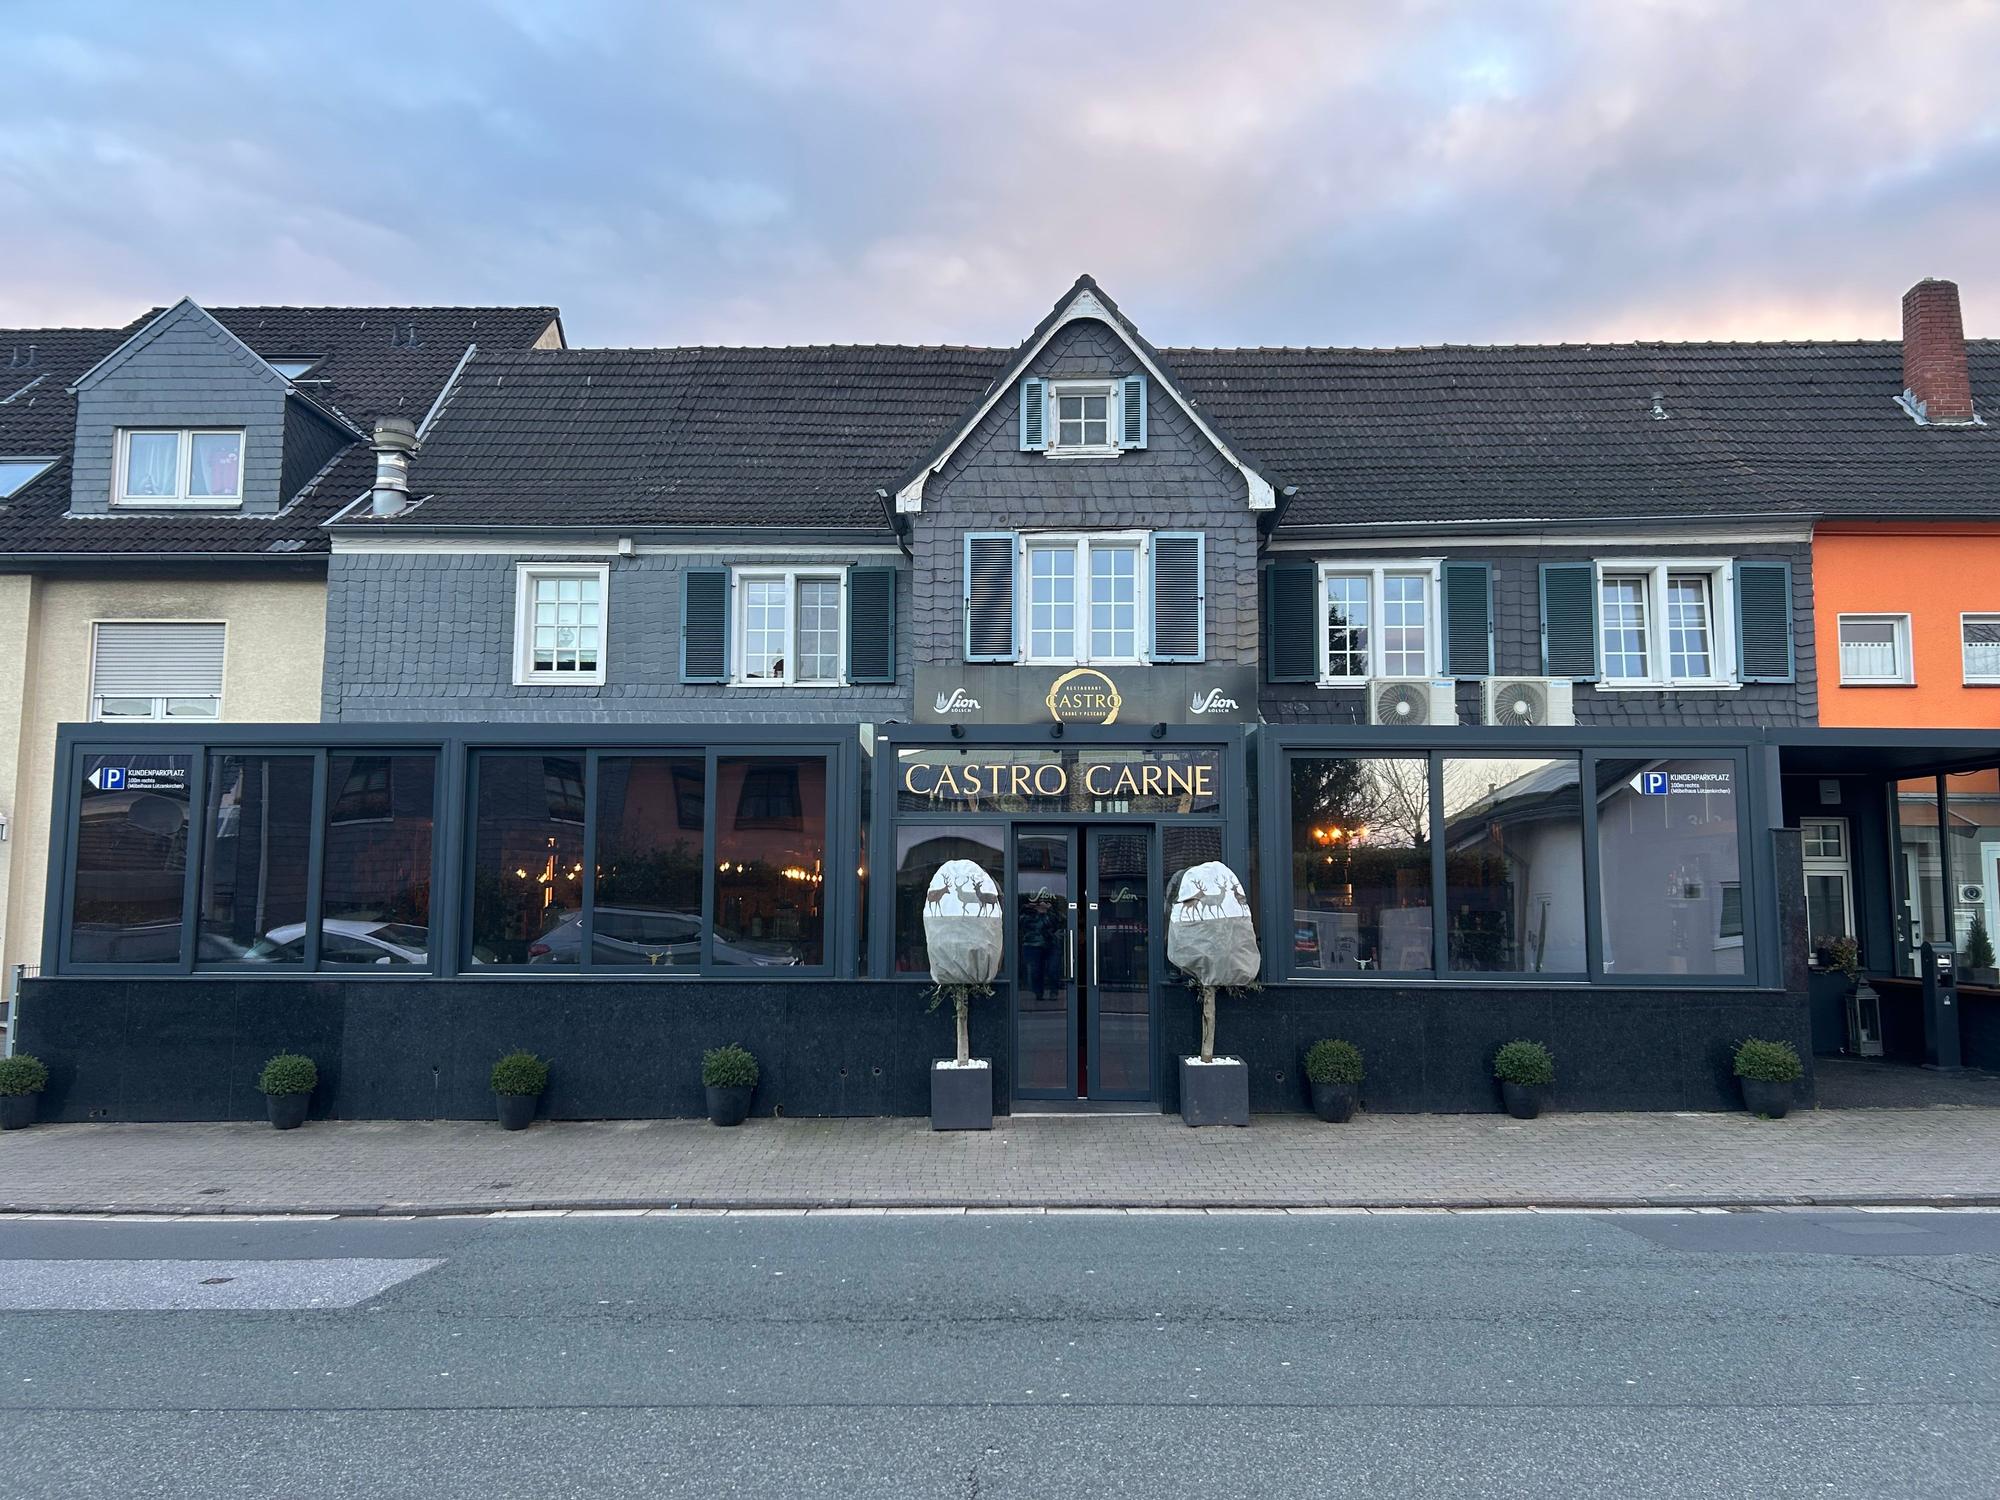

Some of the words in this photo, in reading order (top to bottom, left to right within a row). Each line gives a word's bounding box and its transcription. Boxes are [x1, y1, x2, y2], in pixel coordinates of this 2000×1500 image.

[933, 687, 981, 714] Sion
[1046, 694, 1122, 708] CASTRO
[1189, 687, 1239, 714] Sion
[107, 769, 120, 788] P
[128, 769, 185, 777] KUNDENPARKPLATZ
[905, 764, 1067, 795] CASTRO
[1085, 765, 1213, 796] CARNE
[1649, 774, 1662, 793] P
